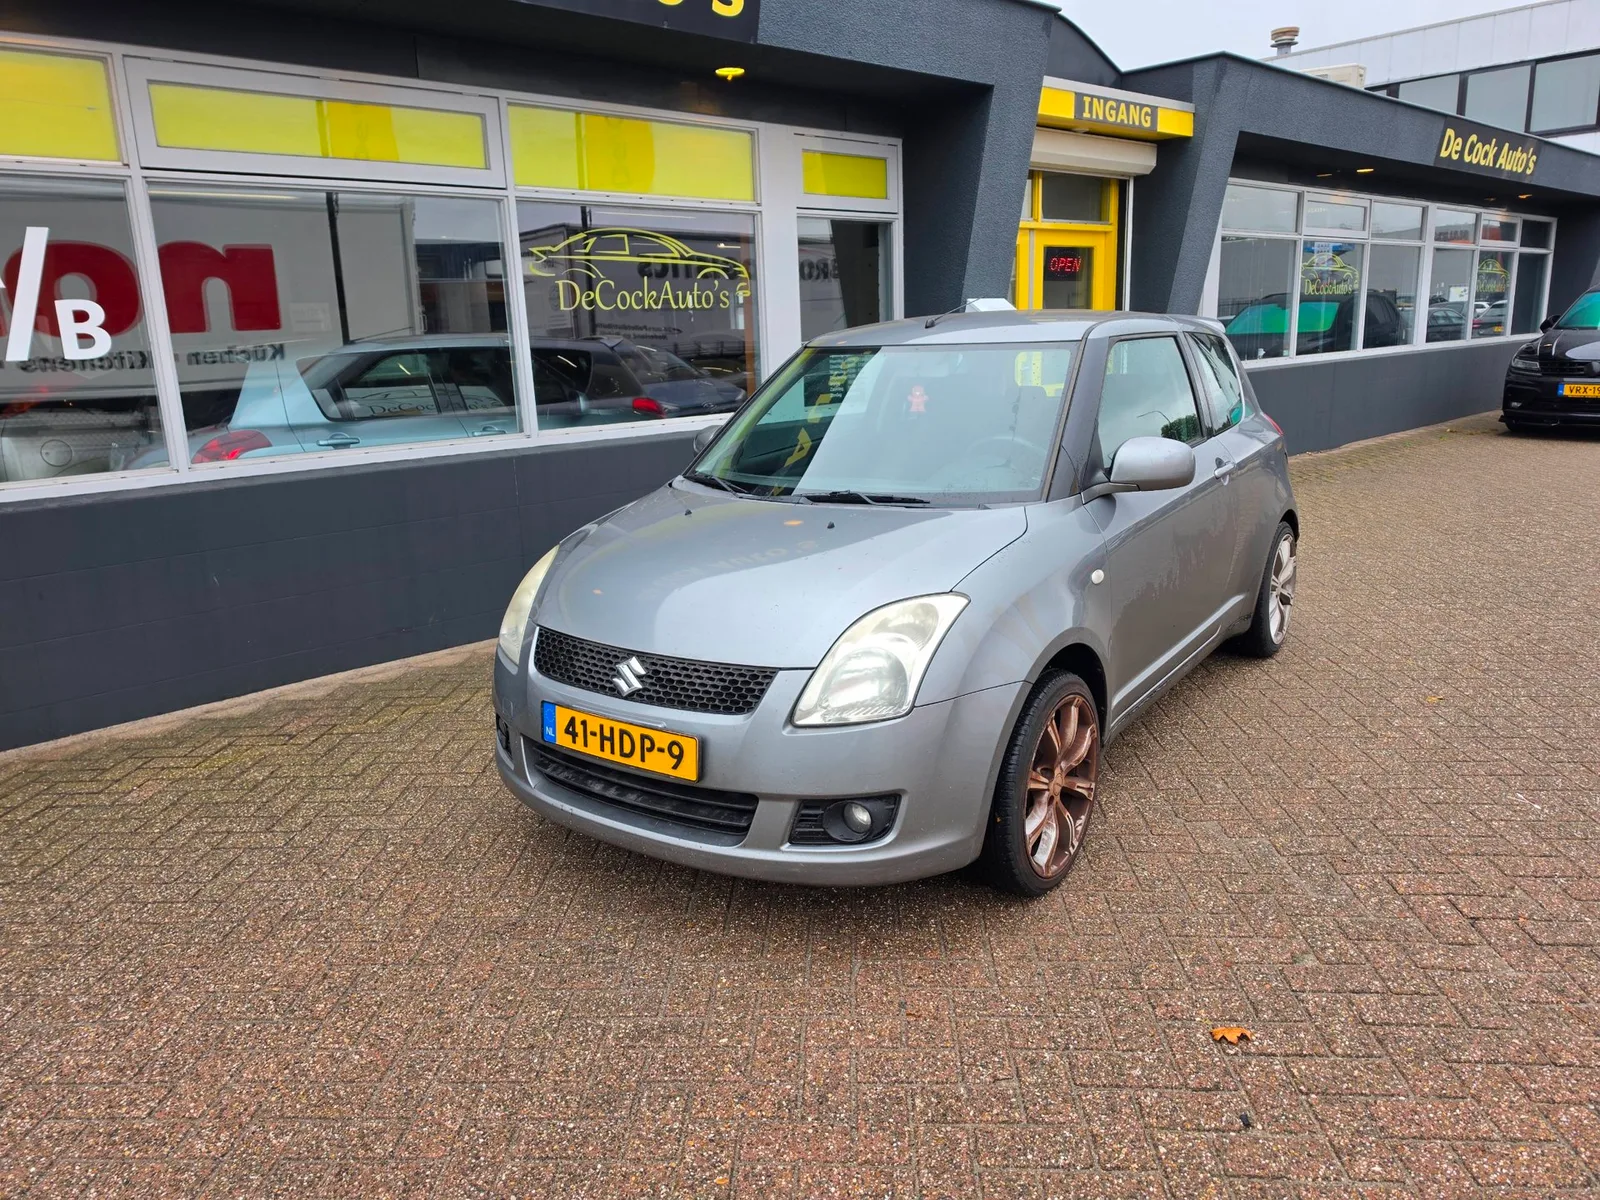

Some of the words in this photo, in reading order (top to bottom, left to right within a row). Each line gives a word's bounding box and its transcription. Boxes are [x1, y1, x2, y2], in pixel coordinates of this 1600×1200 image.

[1083, 96, 1151, 127] INGANG
[1440, 128, 1463, 160] De
[1463, 133, 1498, 167] Cock
[1495, 142, 1537, 175] Auto's
[1050, 255, 1082, 272] OPEN
[554, 276, 729, 311] DeCockAuto's
[545, 726, 555, 737] NL
[564, 716, 685, 770] 41-HDP-9
